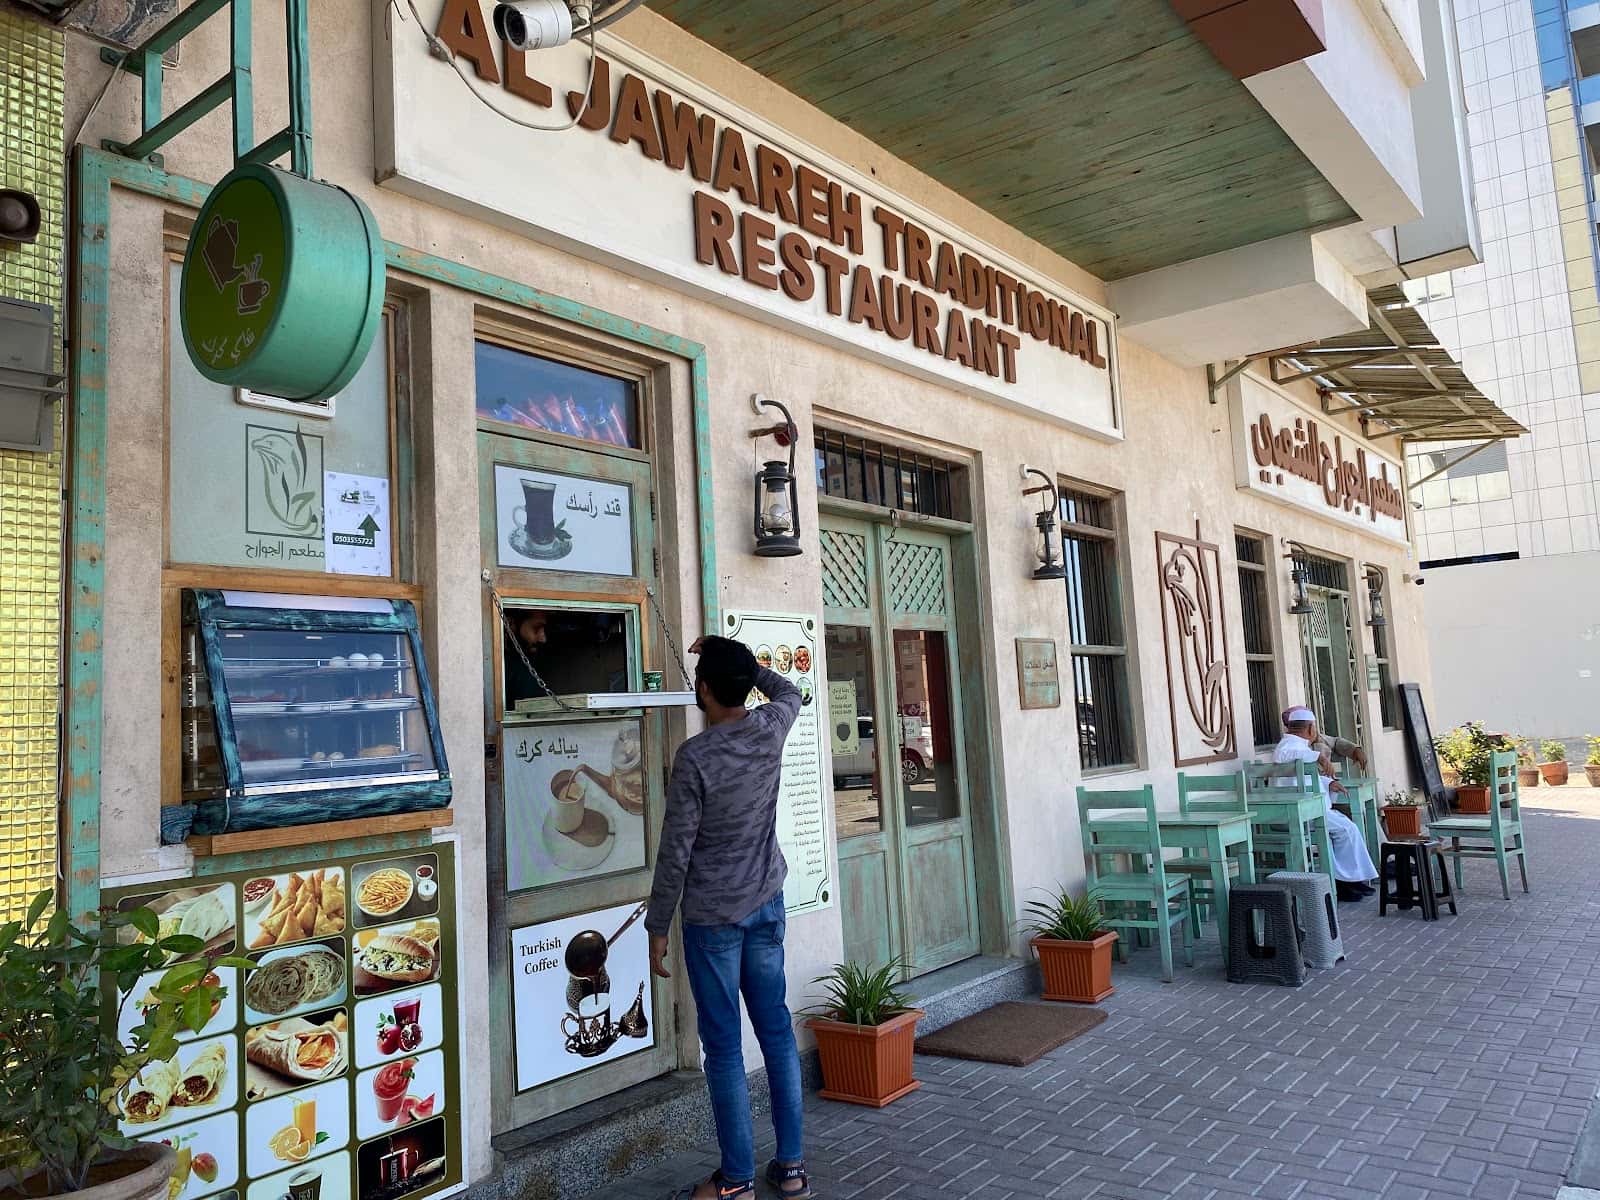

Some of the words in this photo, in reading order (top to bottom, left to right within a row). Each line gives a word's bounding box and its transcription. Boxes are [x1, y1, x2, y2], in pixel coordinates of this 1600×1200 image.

[436, 0, 553, 108] AL
[567, 56, 864, 256] JAWAREH
[873, 205, 1107, 370] TRADITIONAL
[694, 189, 1021, 385] RESTAURANT
[1250, 412, 1324, 486] الشعبي
[1320, 435, 1371, 516] الجوارح
[566, 491, 599, 519] رأسك
[1369, 463, 1403, 523] مطعم
[603, 497, 622, 517] قند
[244, 538, 284, 561] الجوارح
[288, 543, 325, 560] مطعم
[515, 738, 543, 763] كرك
[520, 937, 562, 957] Turkish
[524, 957, 559, 975] Coffee
